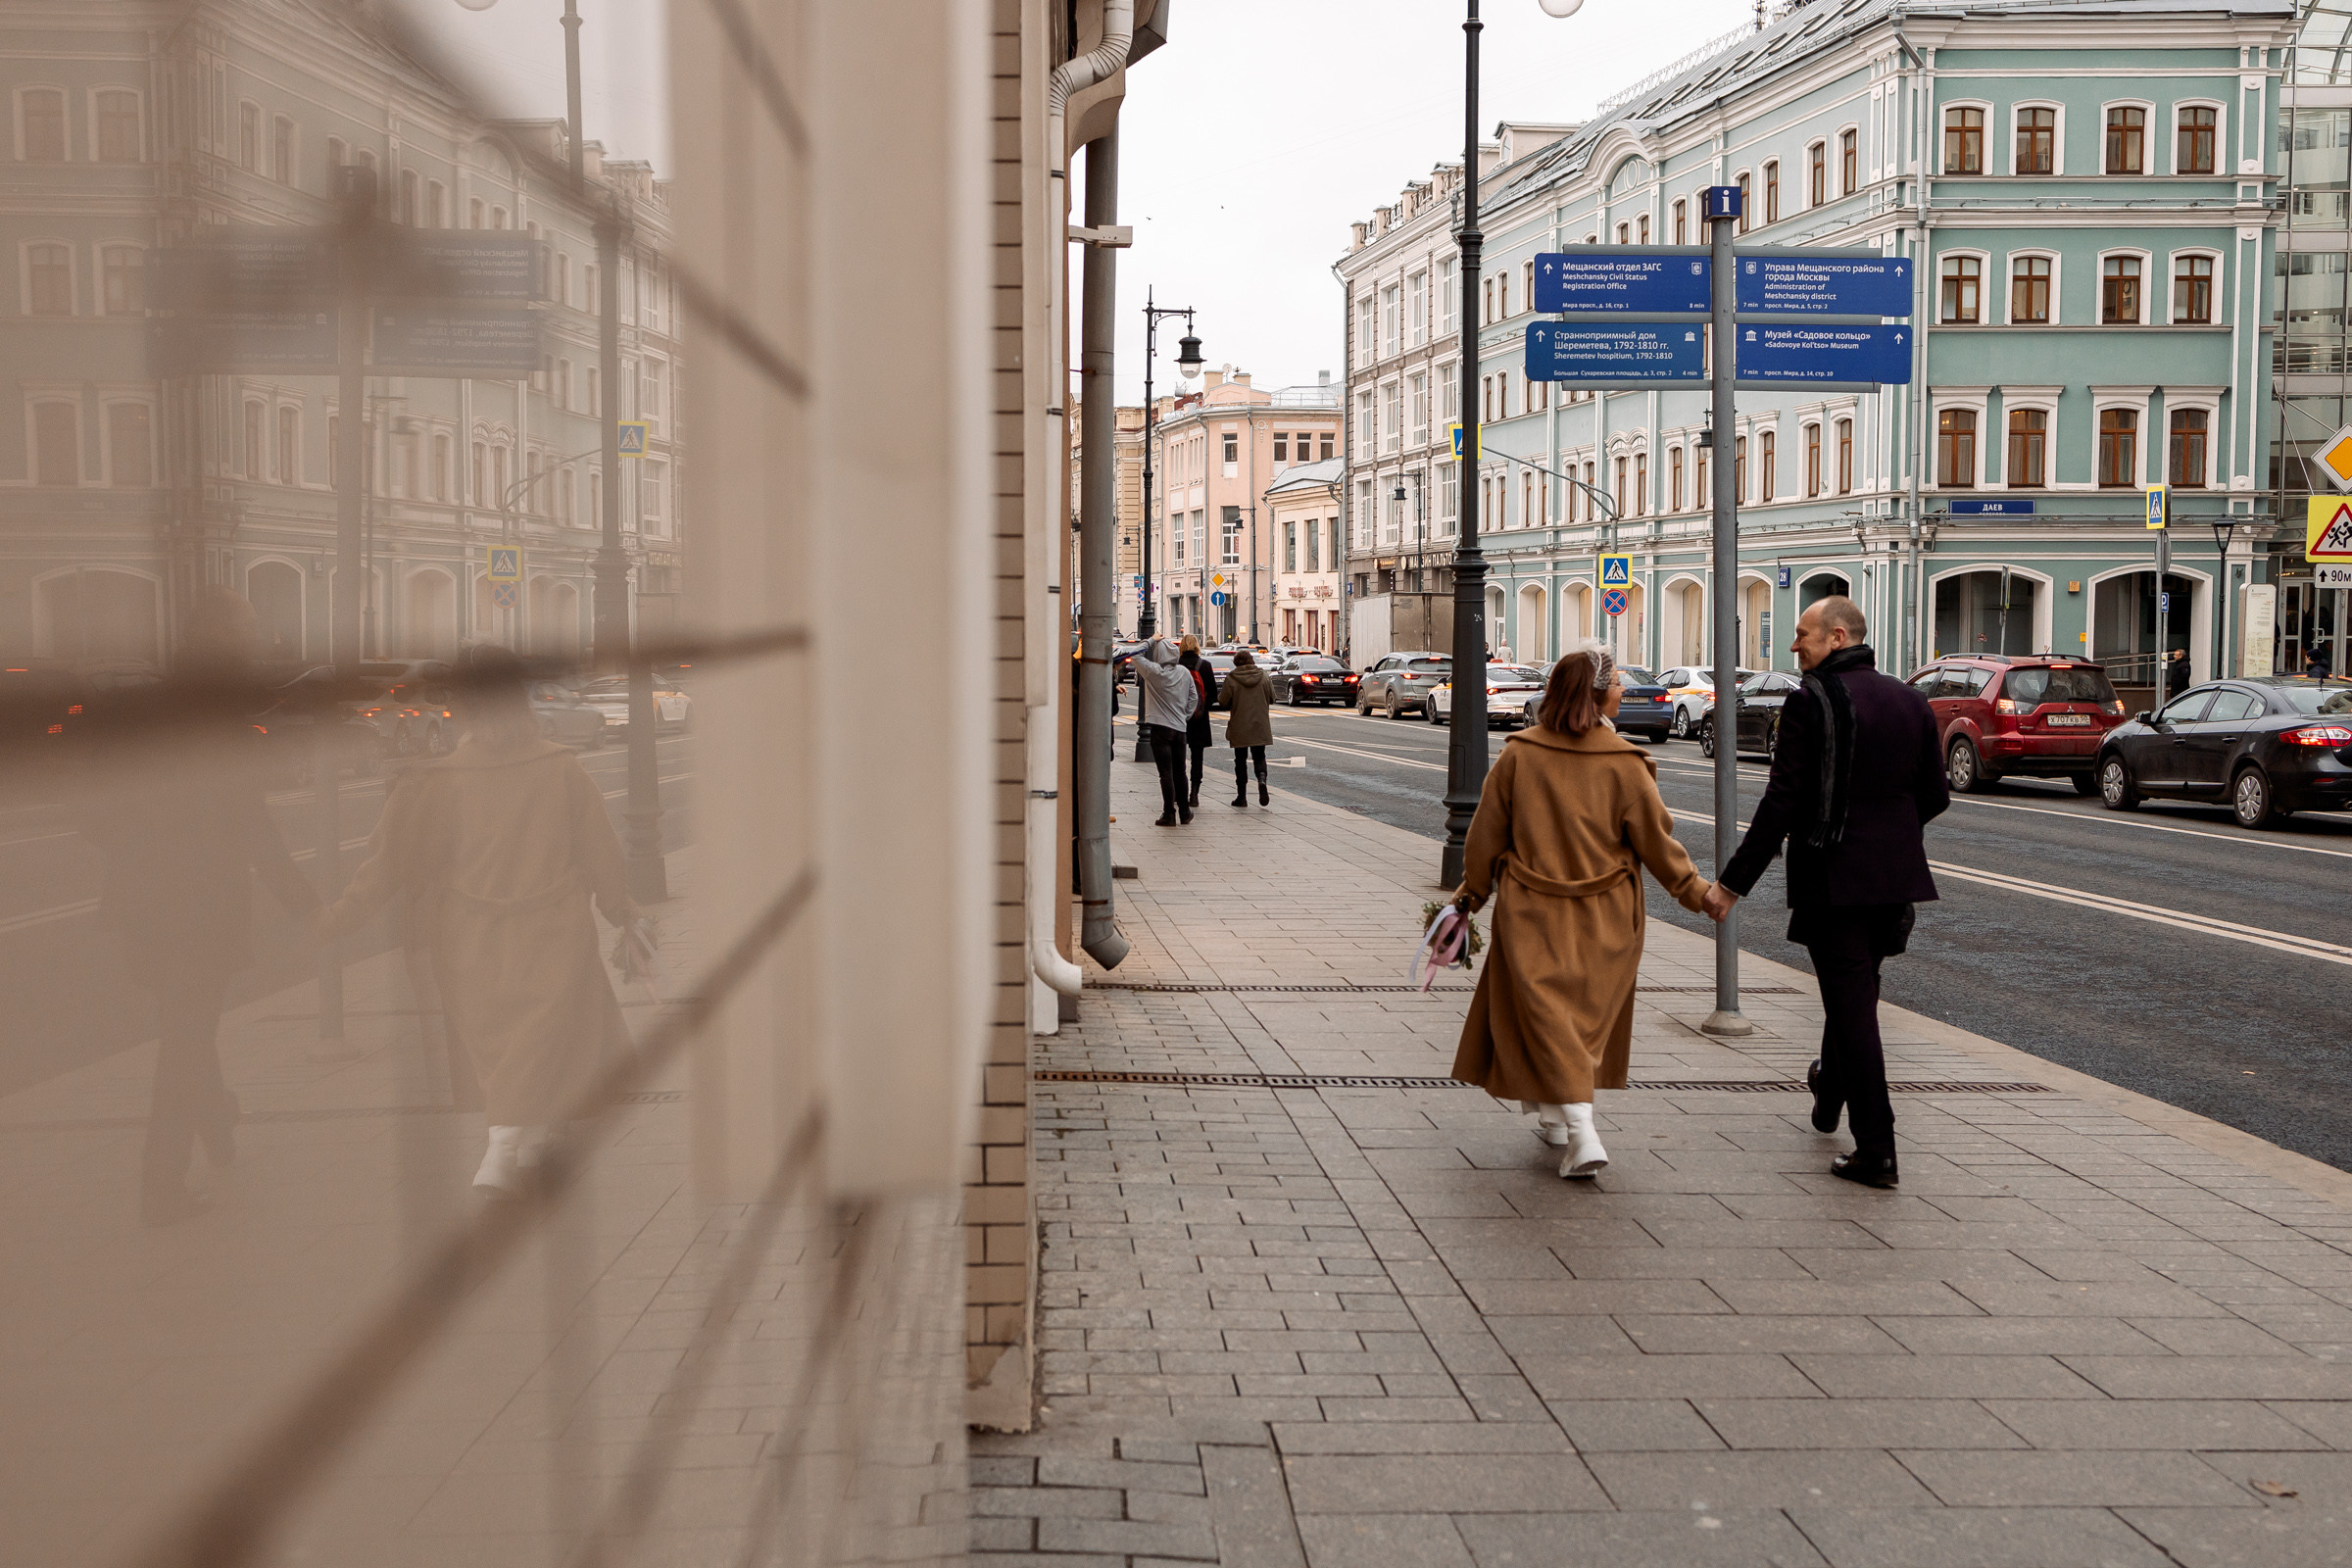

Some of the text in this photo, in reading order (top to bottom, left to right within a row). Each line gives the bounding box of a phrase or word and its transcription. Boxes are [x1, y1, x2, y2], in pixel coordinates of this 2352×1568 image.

[1562, 263, 1614, 271] Мещанский
[1642, 263, 1662, 271] ЗАГС
[1765, 264, 1884, 274] Управа Мещанского района
[1555, 331, 1637, 340] Странноприимный
[1765, 330, 1791, 340] Музей
[1793, 331, 1834, 340] «Садовое
[1555, 342, 1611, 351] Шереметева,
[1780, 572, 1787, 581] 28
